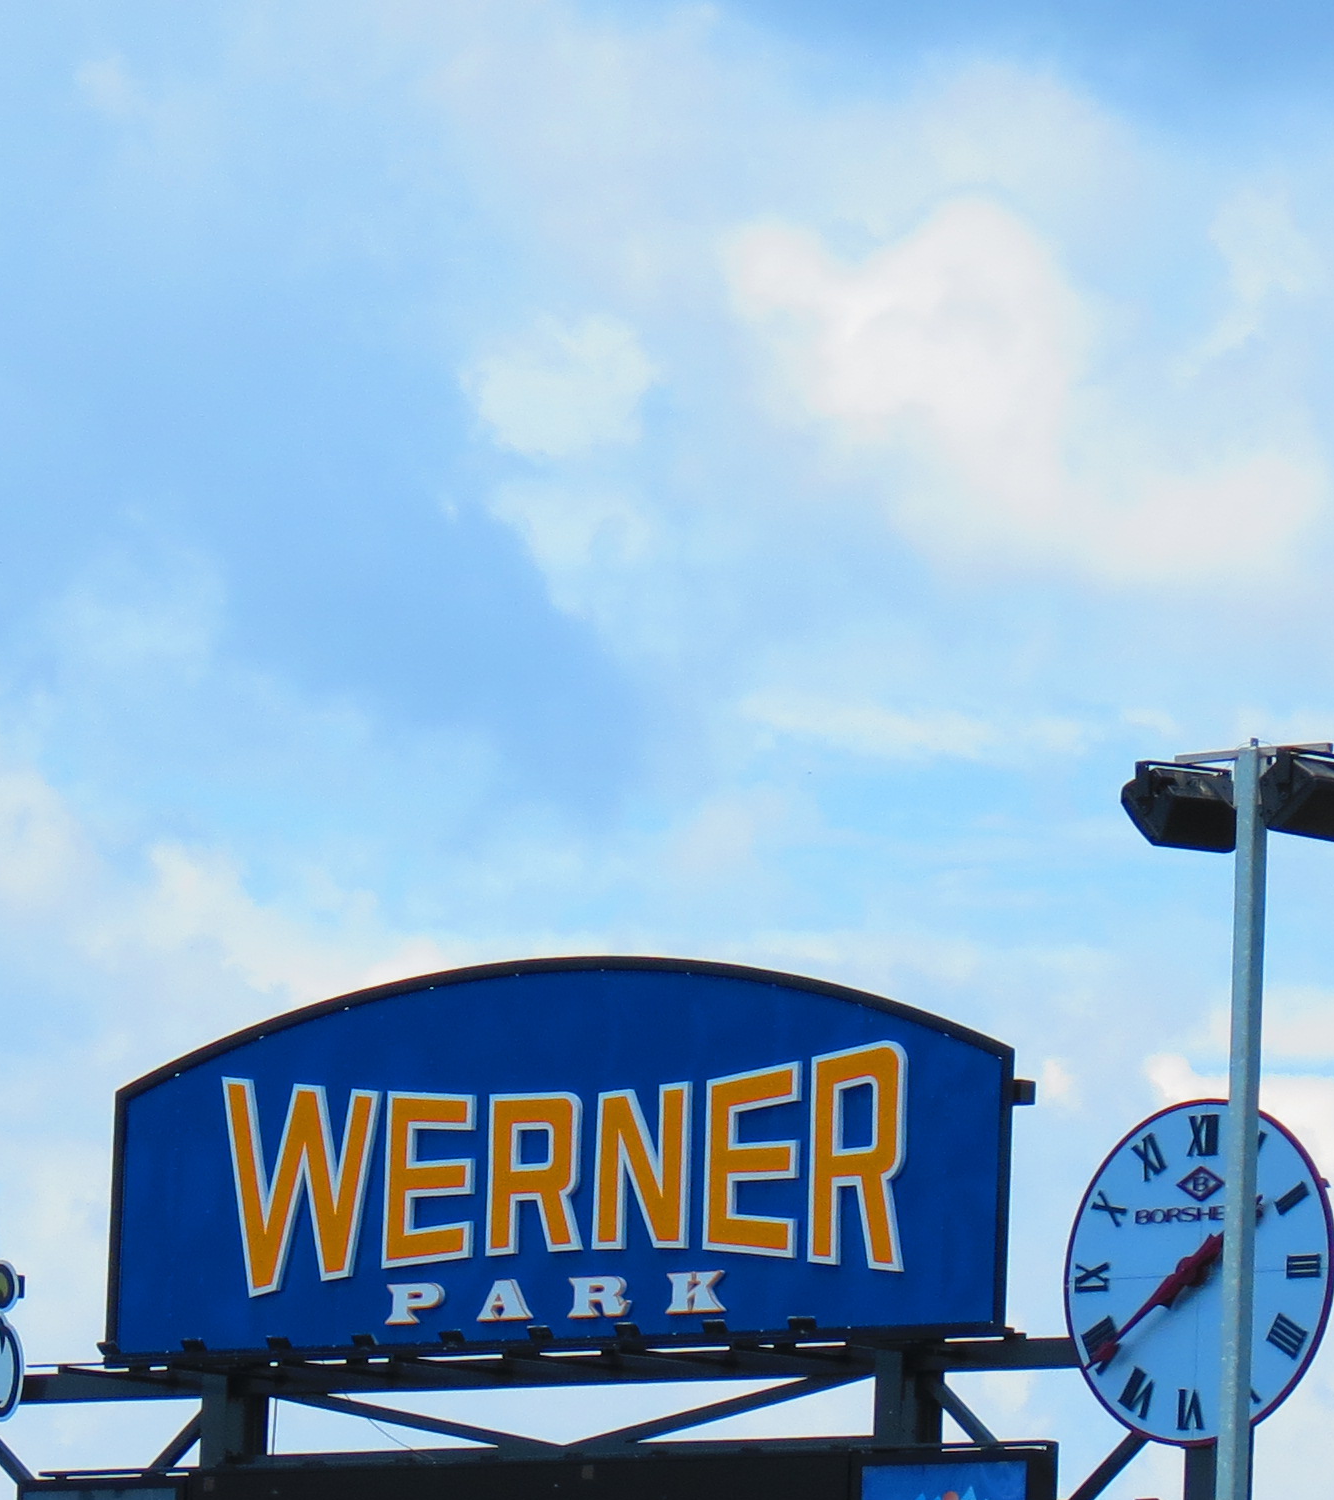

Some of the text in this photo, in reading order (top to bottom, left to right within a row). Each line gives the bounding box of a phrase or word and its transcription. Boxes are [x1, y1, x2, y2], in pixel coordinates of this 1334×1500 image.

[221, 1039, 907, 1298] WERNER
[1134, 1205, 1225, 1225] BORSHE
[384, 1269, 727, 1325] PARK
